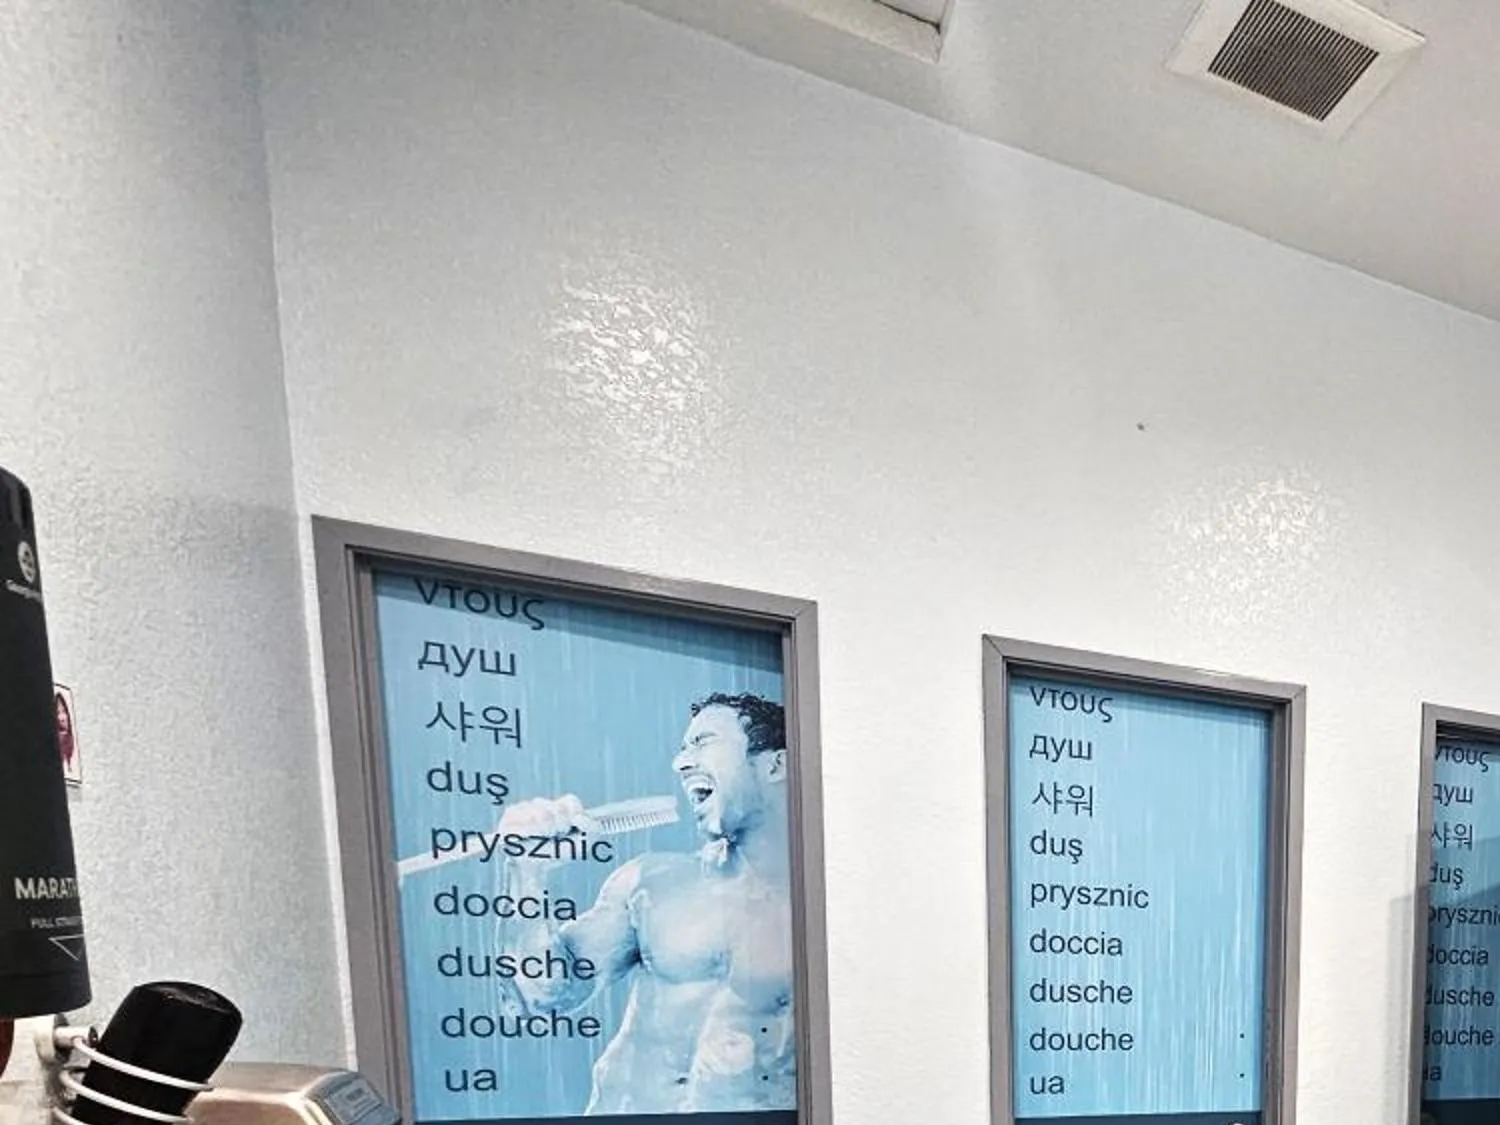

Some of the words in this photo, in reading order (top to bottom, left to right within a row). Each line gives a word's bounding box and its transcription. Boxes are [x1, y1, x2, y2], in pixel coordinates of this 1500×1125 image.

[418, 641, 516, 677] душ
[425, 701, 522, 749] 샤워
[1029, 733, 1093, 763] душ
[426, 761, 510, 805] duş
[1031, 781, 1094, 818] 샤워
[431, 827, 614, 863] prysznic
[1030, 830, 1083, 864] duş
[433, 885, 578, 922] doccia
[1031, 882, 1149, 910] prysznic
[1030, 929, 1123, 956] doccia
[437, 947, 597, 980] dusche
[1030, 978, 1133, 1004] dusche
[440, 1008, 602, 1039] douche
[1030, 1027, 1134, 1051] douche
[445, 1067, 499, 1092] ua
[1030, 1075, 1065, 1095] ua
